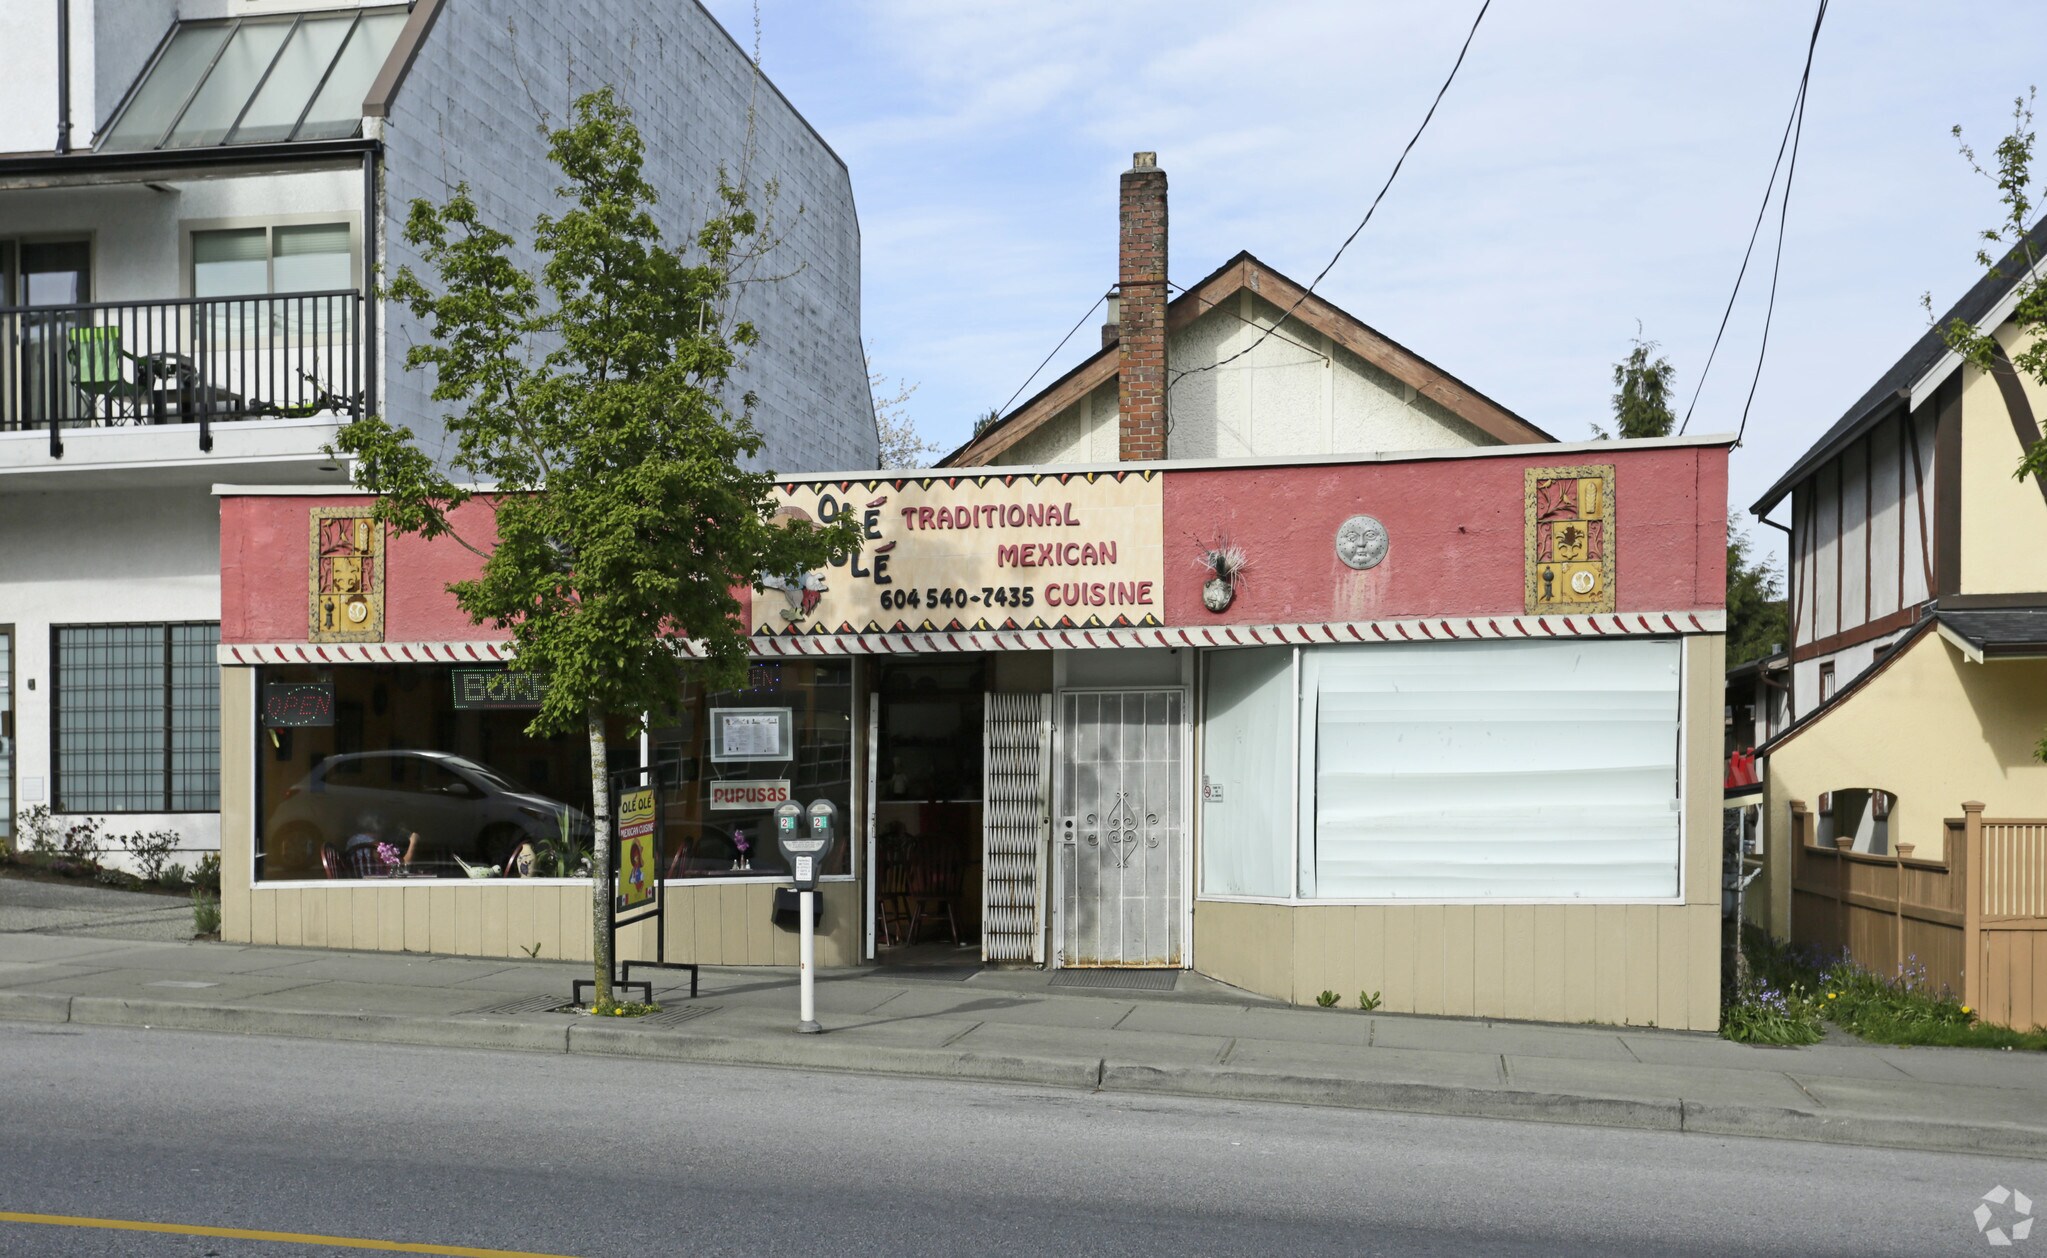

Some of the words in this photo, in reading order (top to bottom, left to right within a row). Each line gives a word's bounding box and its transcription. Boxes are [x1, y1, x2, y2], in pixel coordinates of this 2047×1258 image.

[901, 502, 1081, 530] TRADITIONAL
[997, 540, 1117, 567] MEXICAN
[880, 588, 921, 610] 604
[926, 586, 1035, 609] 540-7435
[1044, 581, 1154, 606] CUISINE
[267, 693, 331, 718] OPEN
[622, 793, 637, 814] OLÉ
[638, 790, 653, 811] OLÉ
[620, 827, 639, 838] MEXICAN
[639, 822, 654, 834] CUISINE
[781, 818, 788, 828] 2
[814, 817, 821, 827] 2
